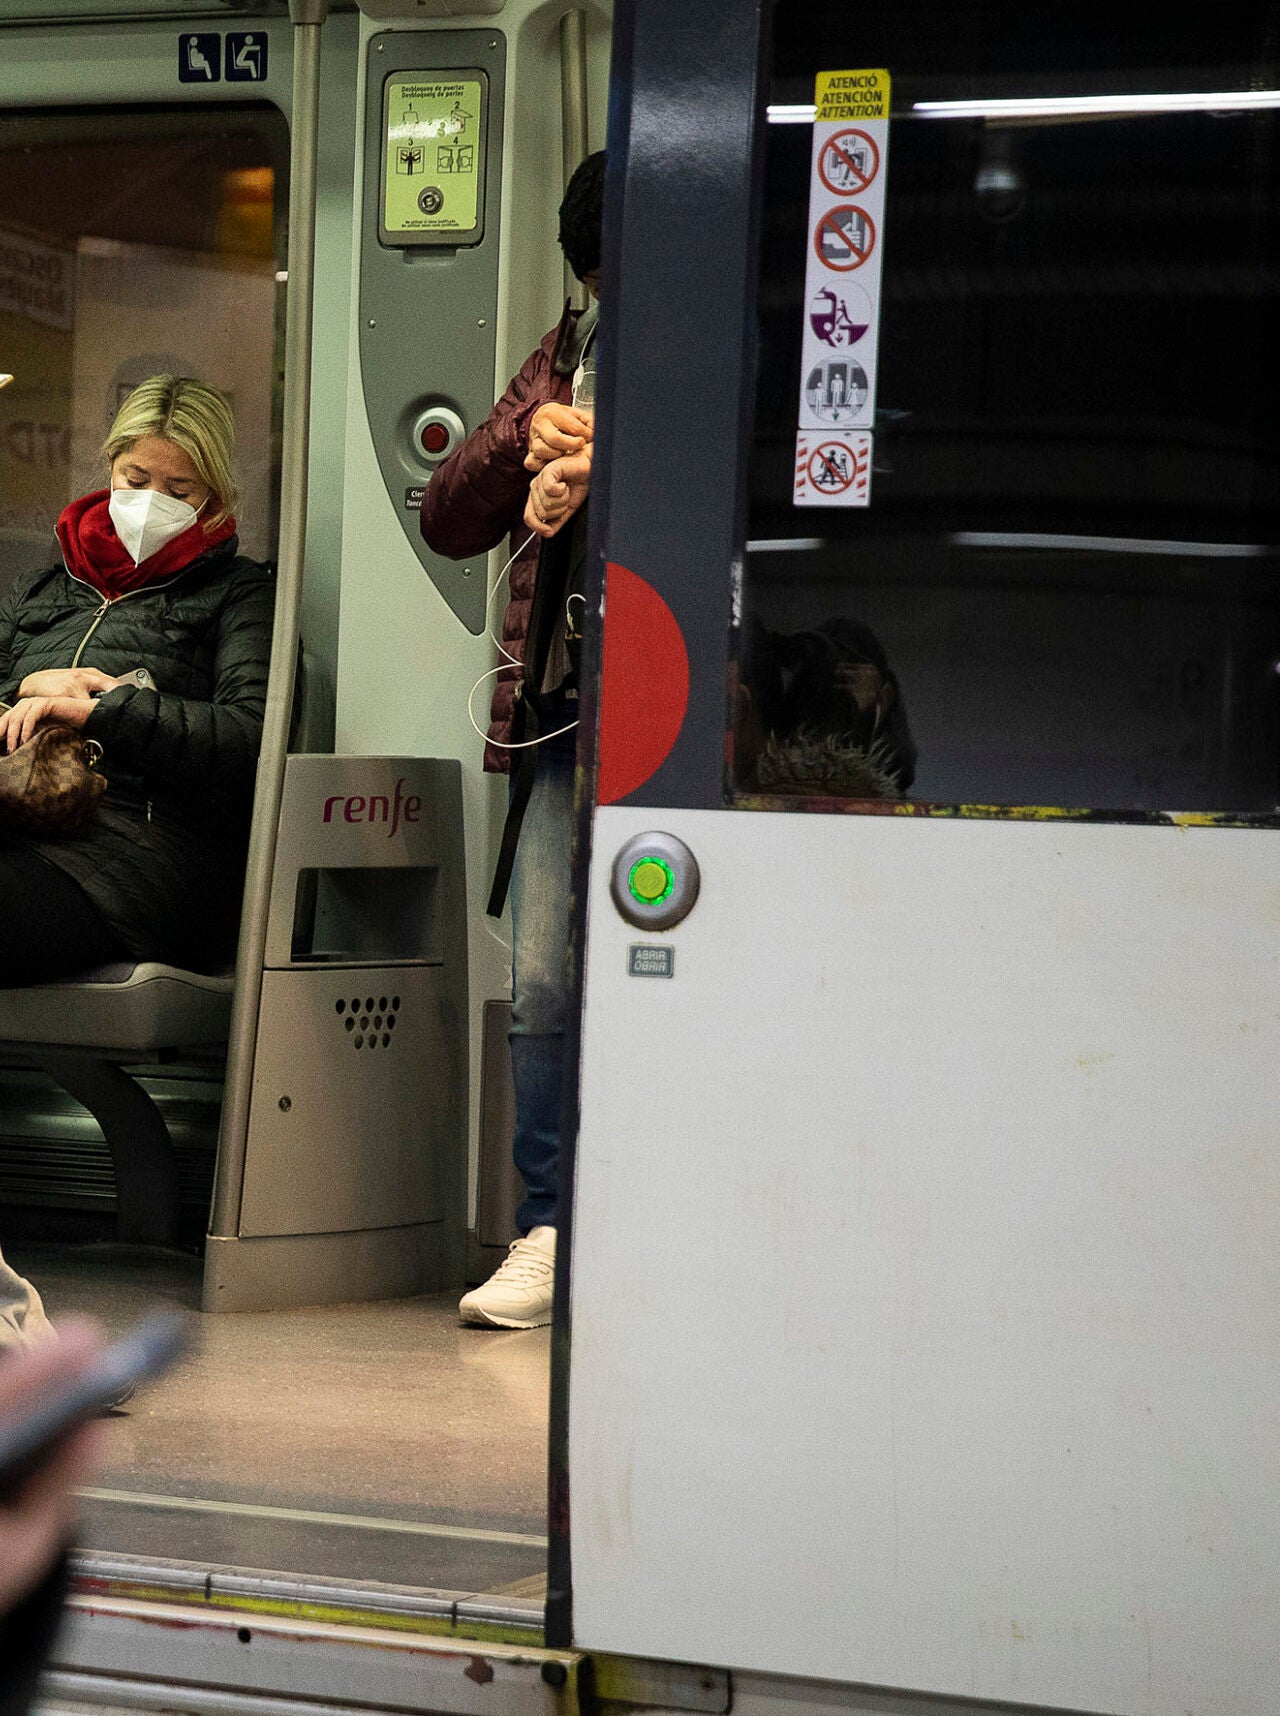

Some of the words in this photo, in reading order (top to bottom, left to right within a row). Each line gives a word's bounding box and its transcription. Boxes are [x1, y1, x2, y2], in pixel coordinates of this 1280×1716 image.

[828, 73, 878, 88] ATENCIÓ
[443, 84, 464, 92] puertas
[822, 89, 882, 104] ATENCIÓN
[408, 103, 413, 111] 1
[455, 101, 460, 109] 2
[819, 104, 884, 118] ATTENTION
[408, 137, 414, 146] 3
[453, 136, 459, 144] 4
[323, 778, 422, 838] renfe
[635, 950, 666, 960] ABRIR
